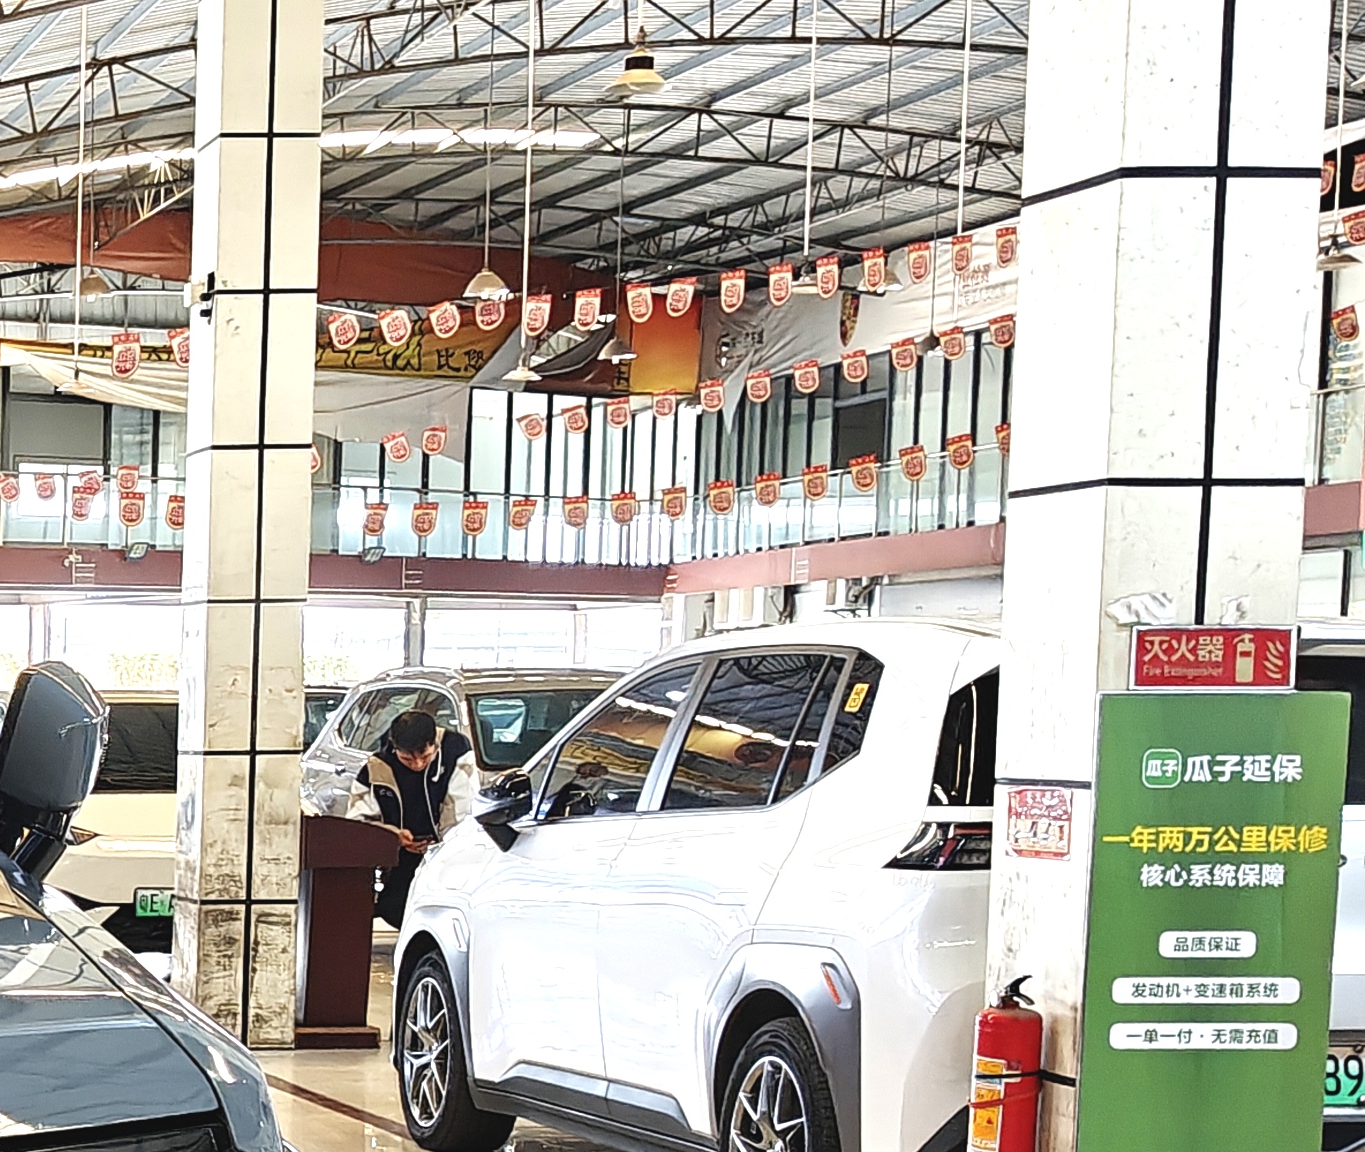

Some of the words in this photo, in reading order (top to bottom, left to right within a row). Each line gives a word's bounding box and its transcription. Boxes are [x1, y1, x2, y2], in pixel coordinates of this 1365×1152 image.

[1142, 634, 1224, 663] 灭火器
[1145, 759, 1178, 777] 瓜子
[1183, 754, 1304, 783] 瓜子延保
[1102, 825, 1329, 854] 一年两万公里保修
[1140, 863, 1286, 889] 核心系统保障
[1173, 936, 1243, 952] 品质保证
[1131, 982, 1280, 999] 发动机+变速箱系统
